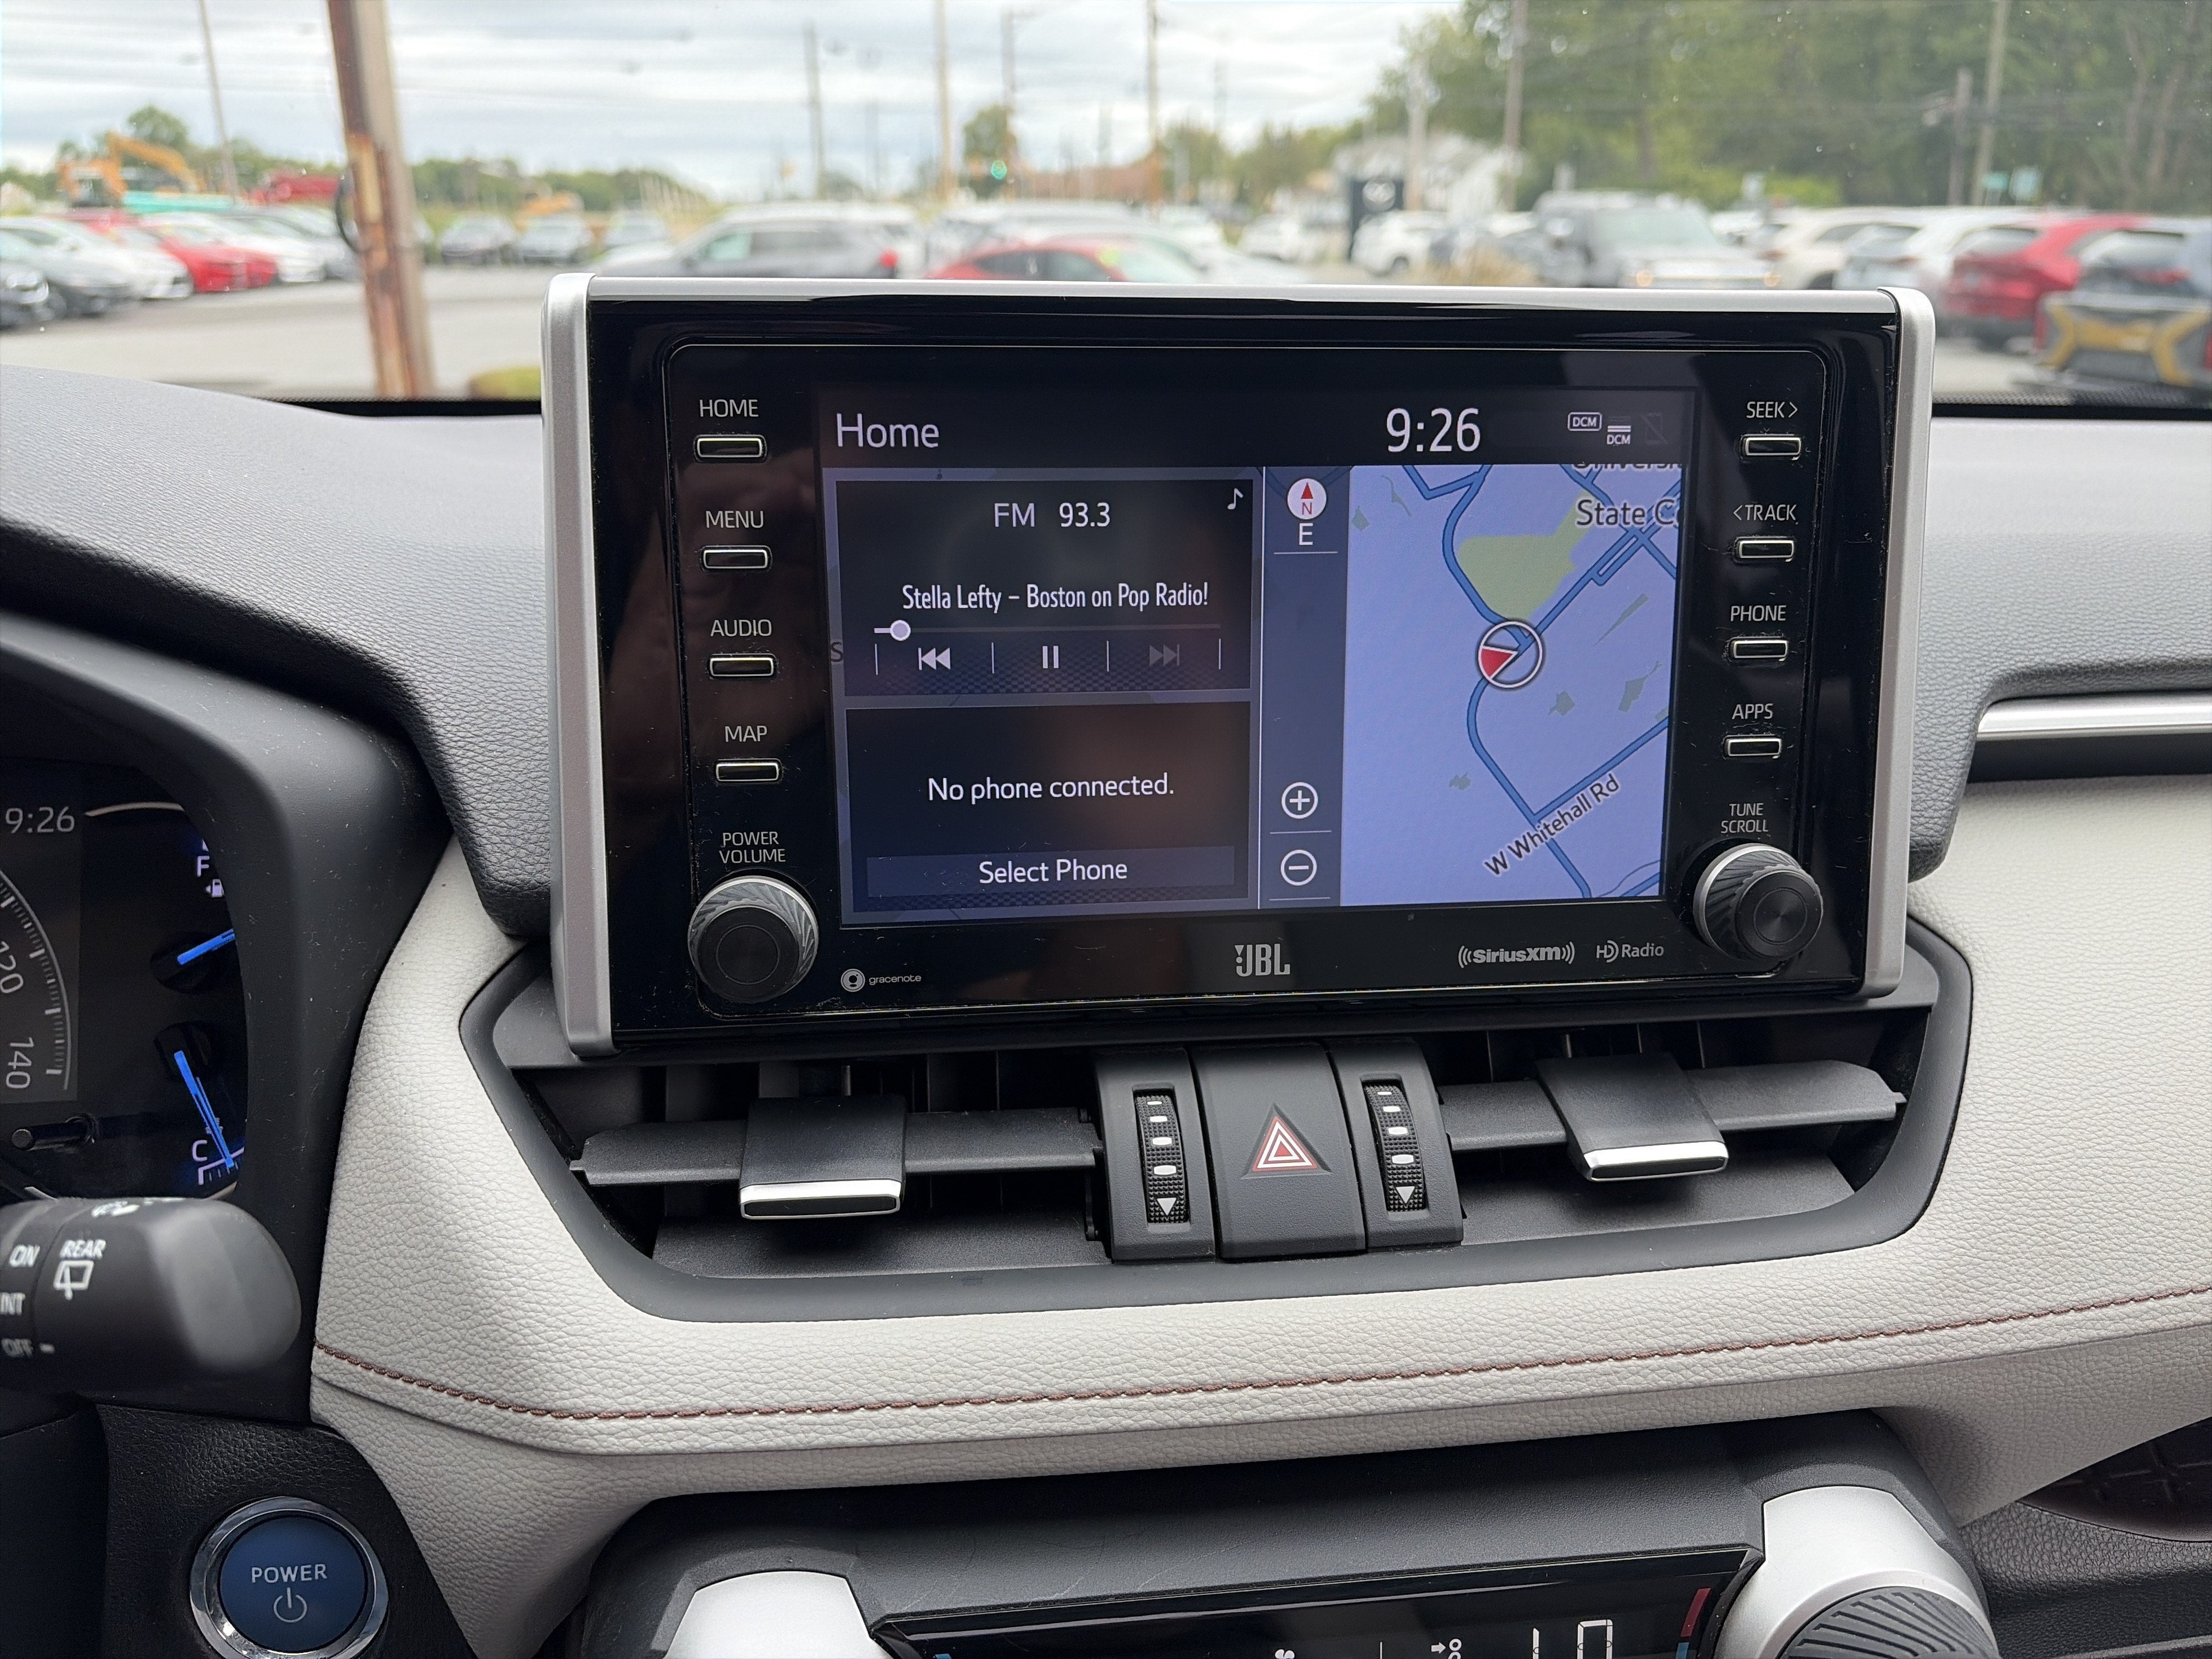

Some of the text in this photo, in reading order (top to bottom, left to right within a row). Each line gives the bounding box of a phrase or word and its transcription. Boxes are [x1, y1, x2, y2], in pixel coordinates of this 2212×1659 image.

[699, 399, 759, 417] HOME
[1746, 401, 1785, 419] SEEK
[836, 413, 939, 448] Home
[1386, 408, 1481, 453] 9:26
[1572, 416, 1597, 427] DCM
[1606, 434, 1631, 445] DCM
[994, 502, 1110, 527] FM 93.3
[1302, 502, 1312, 515] N
[1577, 499, 1680, 526] State C
[1745, 504, 1797, 522] TRACK
[706, 510, 764, 528] MENU
[1299, 522, 1313, 545] E
[902, 584, 951, 609] Stella
[957, 584, 1002, 614] Lefty
[1027, 584, 1086, 608] Boston
[1092, 590, 1112, 607] on
[1118, 583, 1149, 612] Pop
[1156, 582, 1208, 606] Radio!
[1730, 605, 1787, 622] PHONE
[710, 619, 772, 637] AUDIO
[1731, 703, 1773, 720] APPS
[725, 725, 768, 742] MAP
[928, 772, 1174, 805] No phone connected.
[1729, 803, 1764, 816] TUNE
[5, 806, 75, 833] 9:26
[1483, 773, 1620, 875] W Whitehall Rd
[1720, 819, 1769, 834] SCROLL
[722, 831, 779, 846] POWER
[719, 848, 786, 864] VOLUME
[197, 855, 210, 877] F
[979, 858, 1127, 884] Select Phone
[1621, 943, 1664, 958] Radio
[1235, 943, 1290, 977] JBL
[868, 974, 922, 986] gracenote
[5, 1037, 34, 1089] 140
[191, 1139, 208, 1162] C
[9, 1244, 41, 1268] ON
[59, 1239, 106, 1260] REAR
[251, 1564, 327, 1583] POWER
